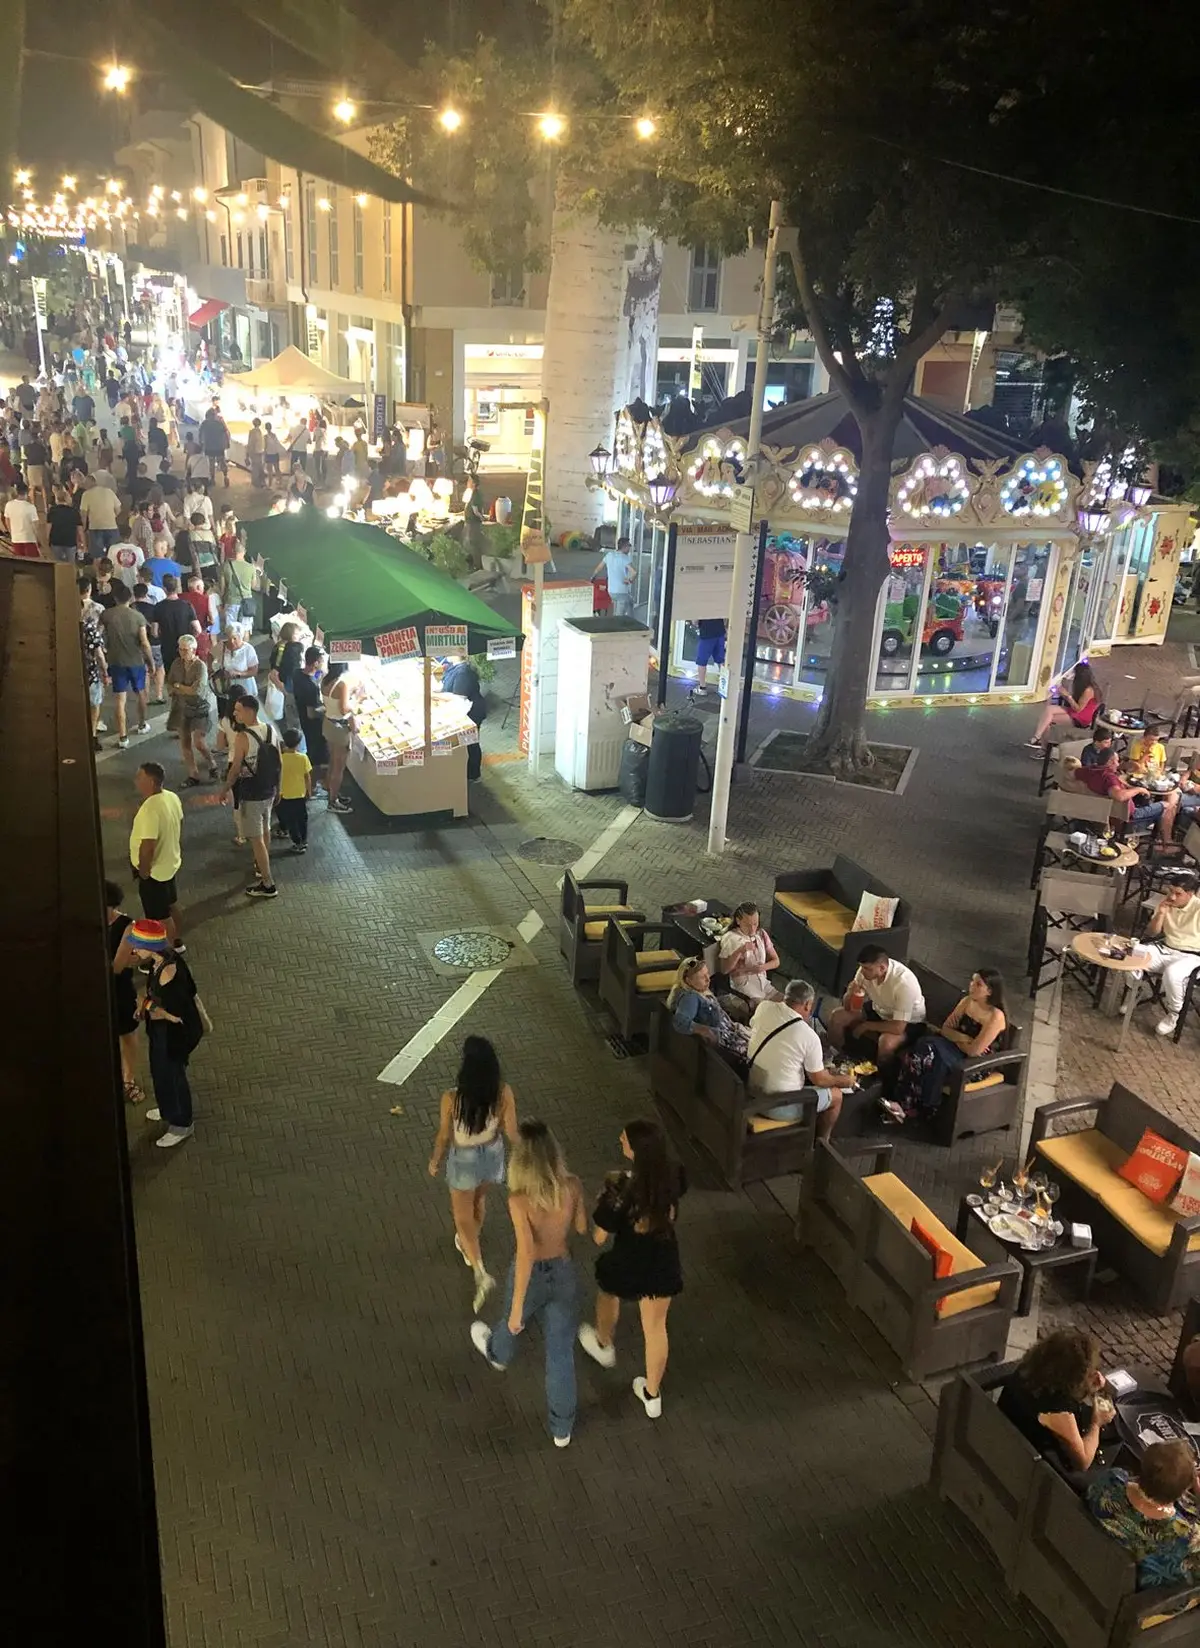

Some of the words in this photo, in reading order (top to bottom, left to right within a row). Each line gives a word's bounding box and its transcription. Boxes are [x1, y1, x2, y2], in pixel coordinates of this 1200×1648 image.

[893, 553, 923, 563] APERTO
[376, 627, 417, 647] SGONFIA
[427, 634, 467, 646] MIRTILLO
[331, 641, 361, 653] ZENZERO
[381, 640, 417, 657] PANCIA
[521, 699, 531, 750] PIAZZA
